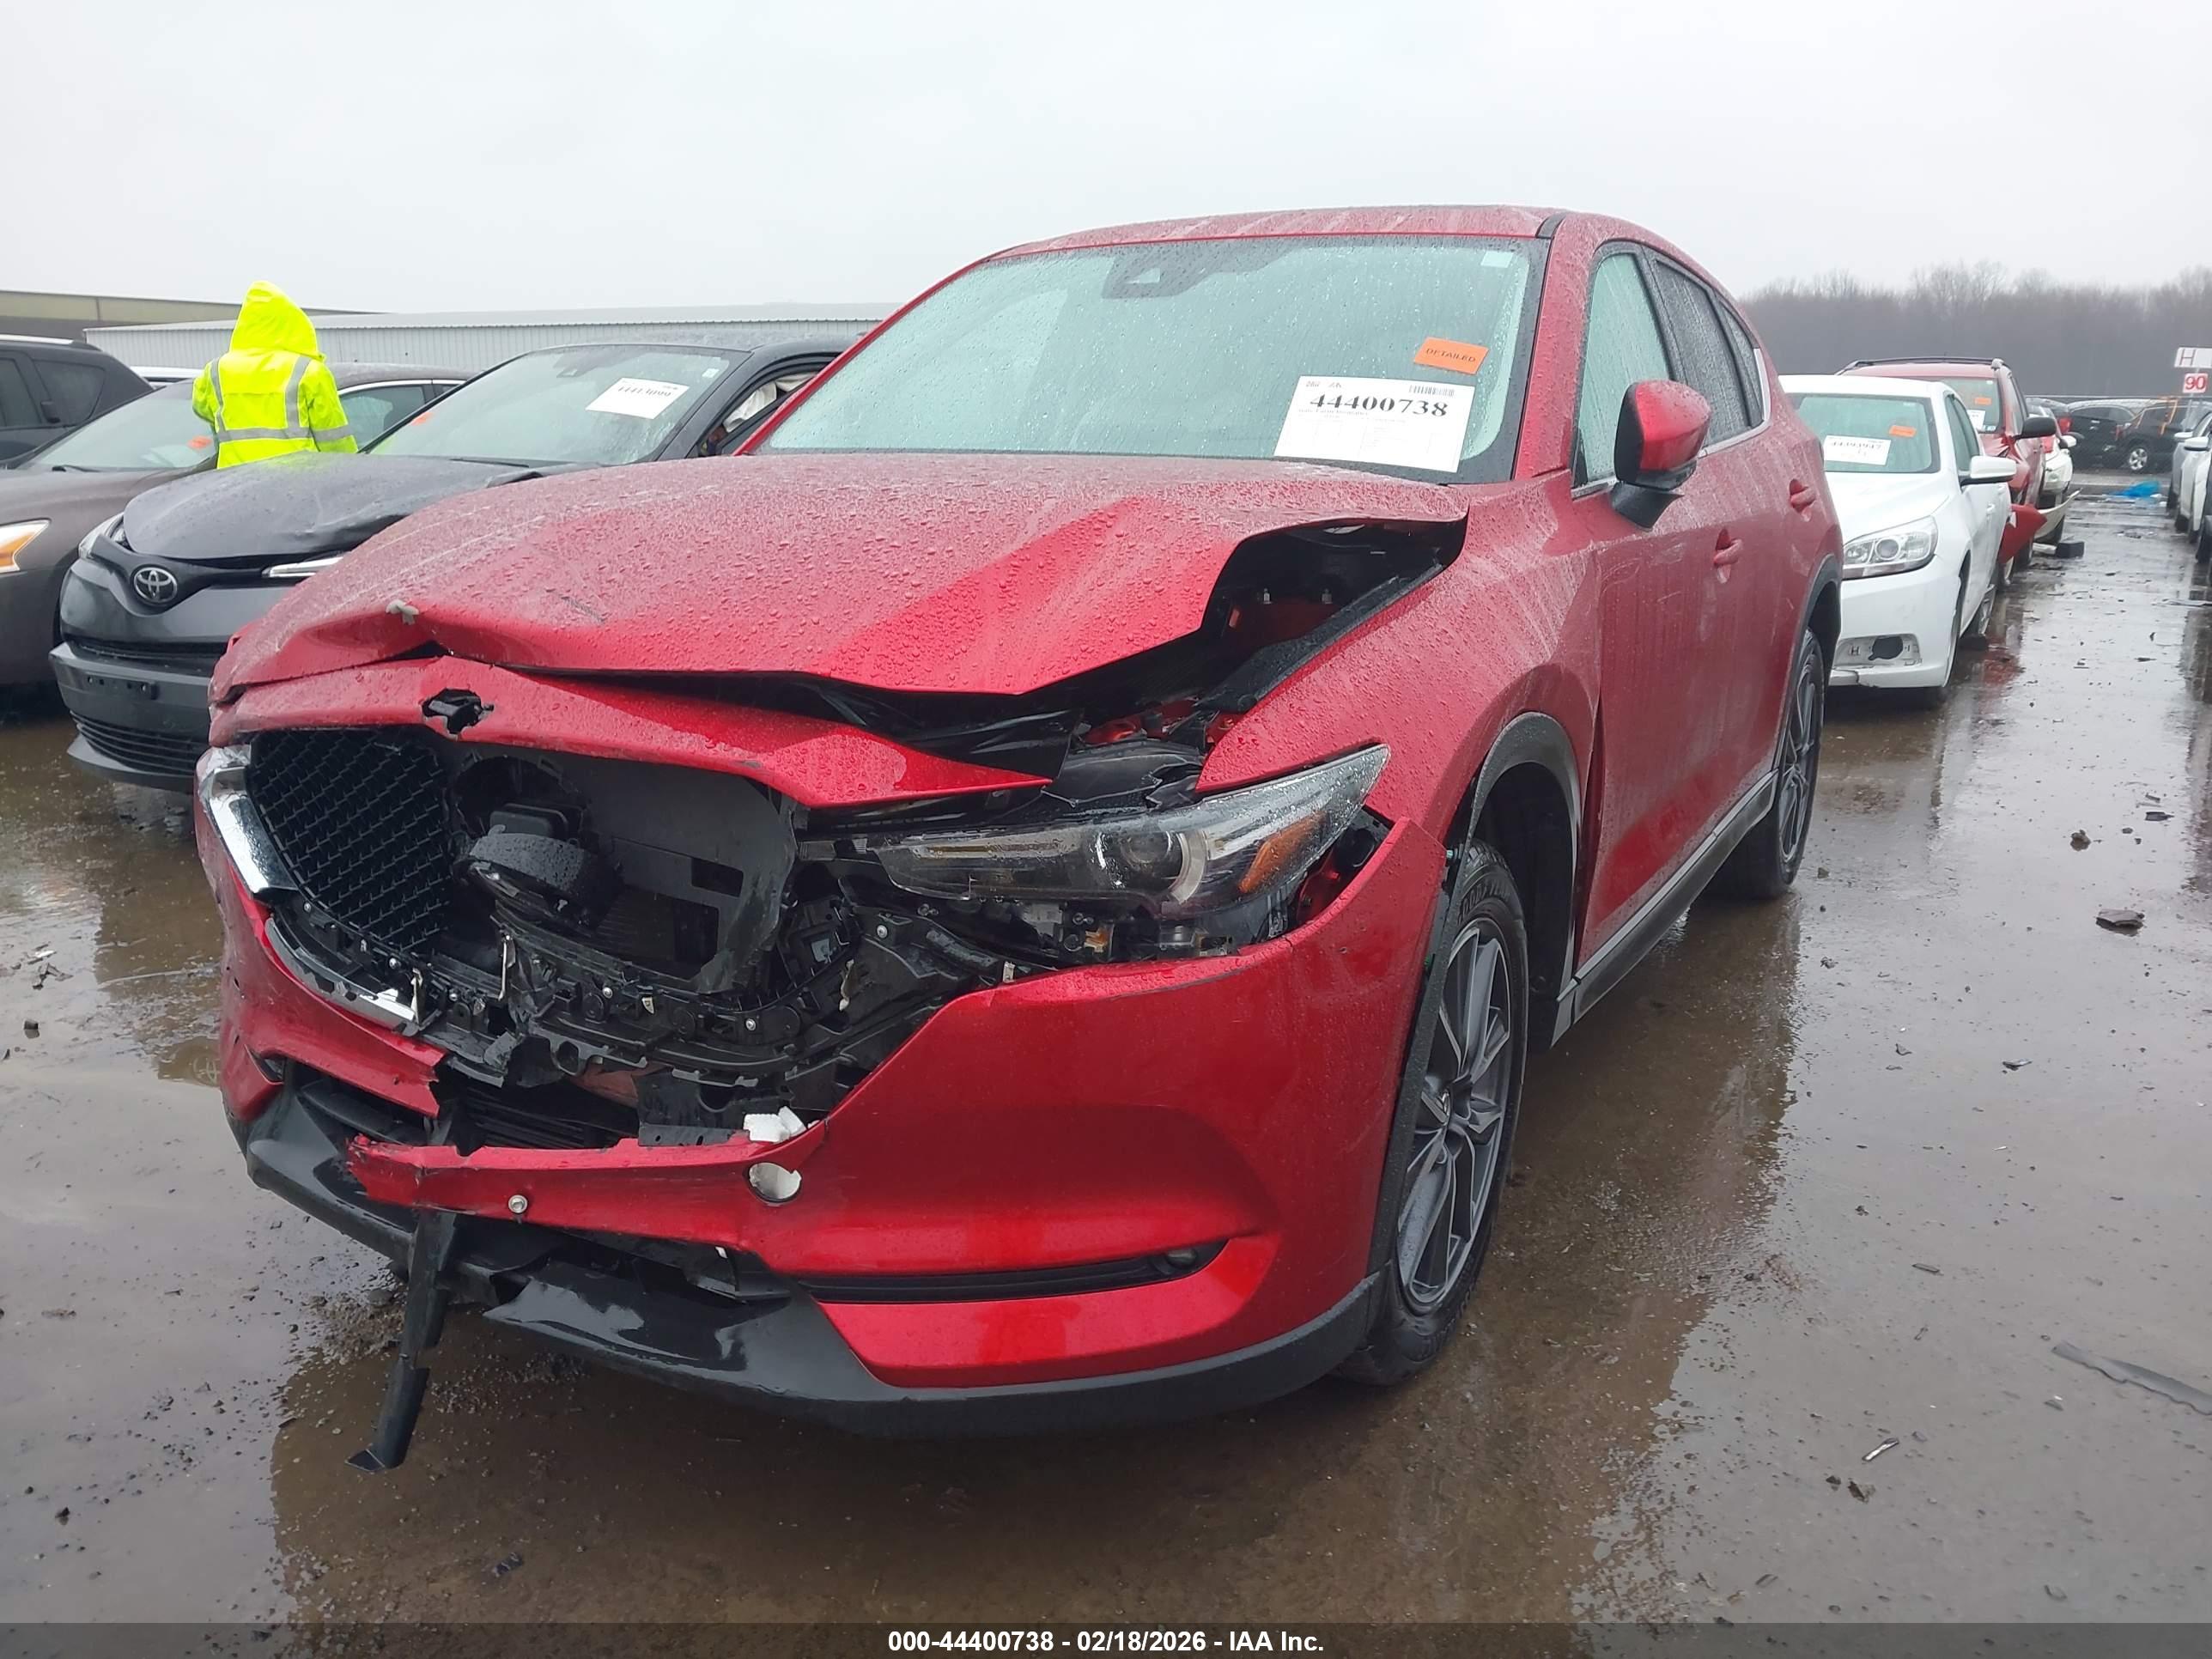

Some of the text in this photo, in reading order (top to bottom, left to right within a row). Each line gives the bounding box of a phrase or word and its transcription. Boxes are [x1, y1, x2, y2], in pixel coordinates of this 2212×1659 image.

[1425, 348, 1476, 362] DETAILED
[2179, 349, 2196, 366] H
[2185, 376, 2206, 390] 90
[1310, 393, 1449, 417] 44400738
